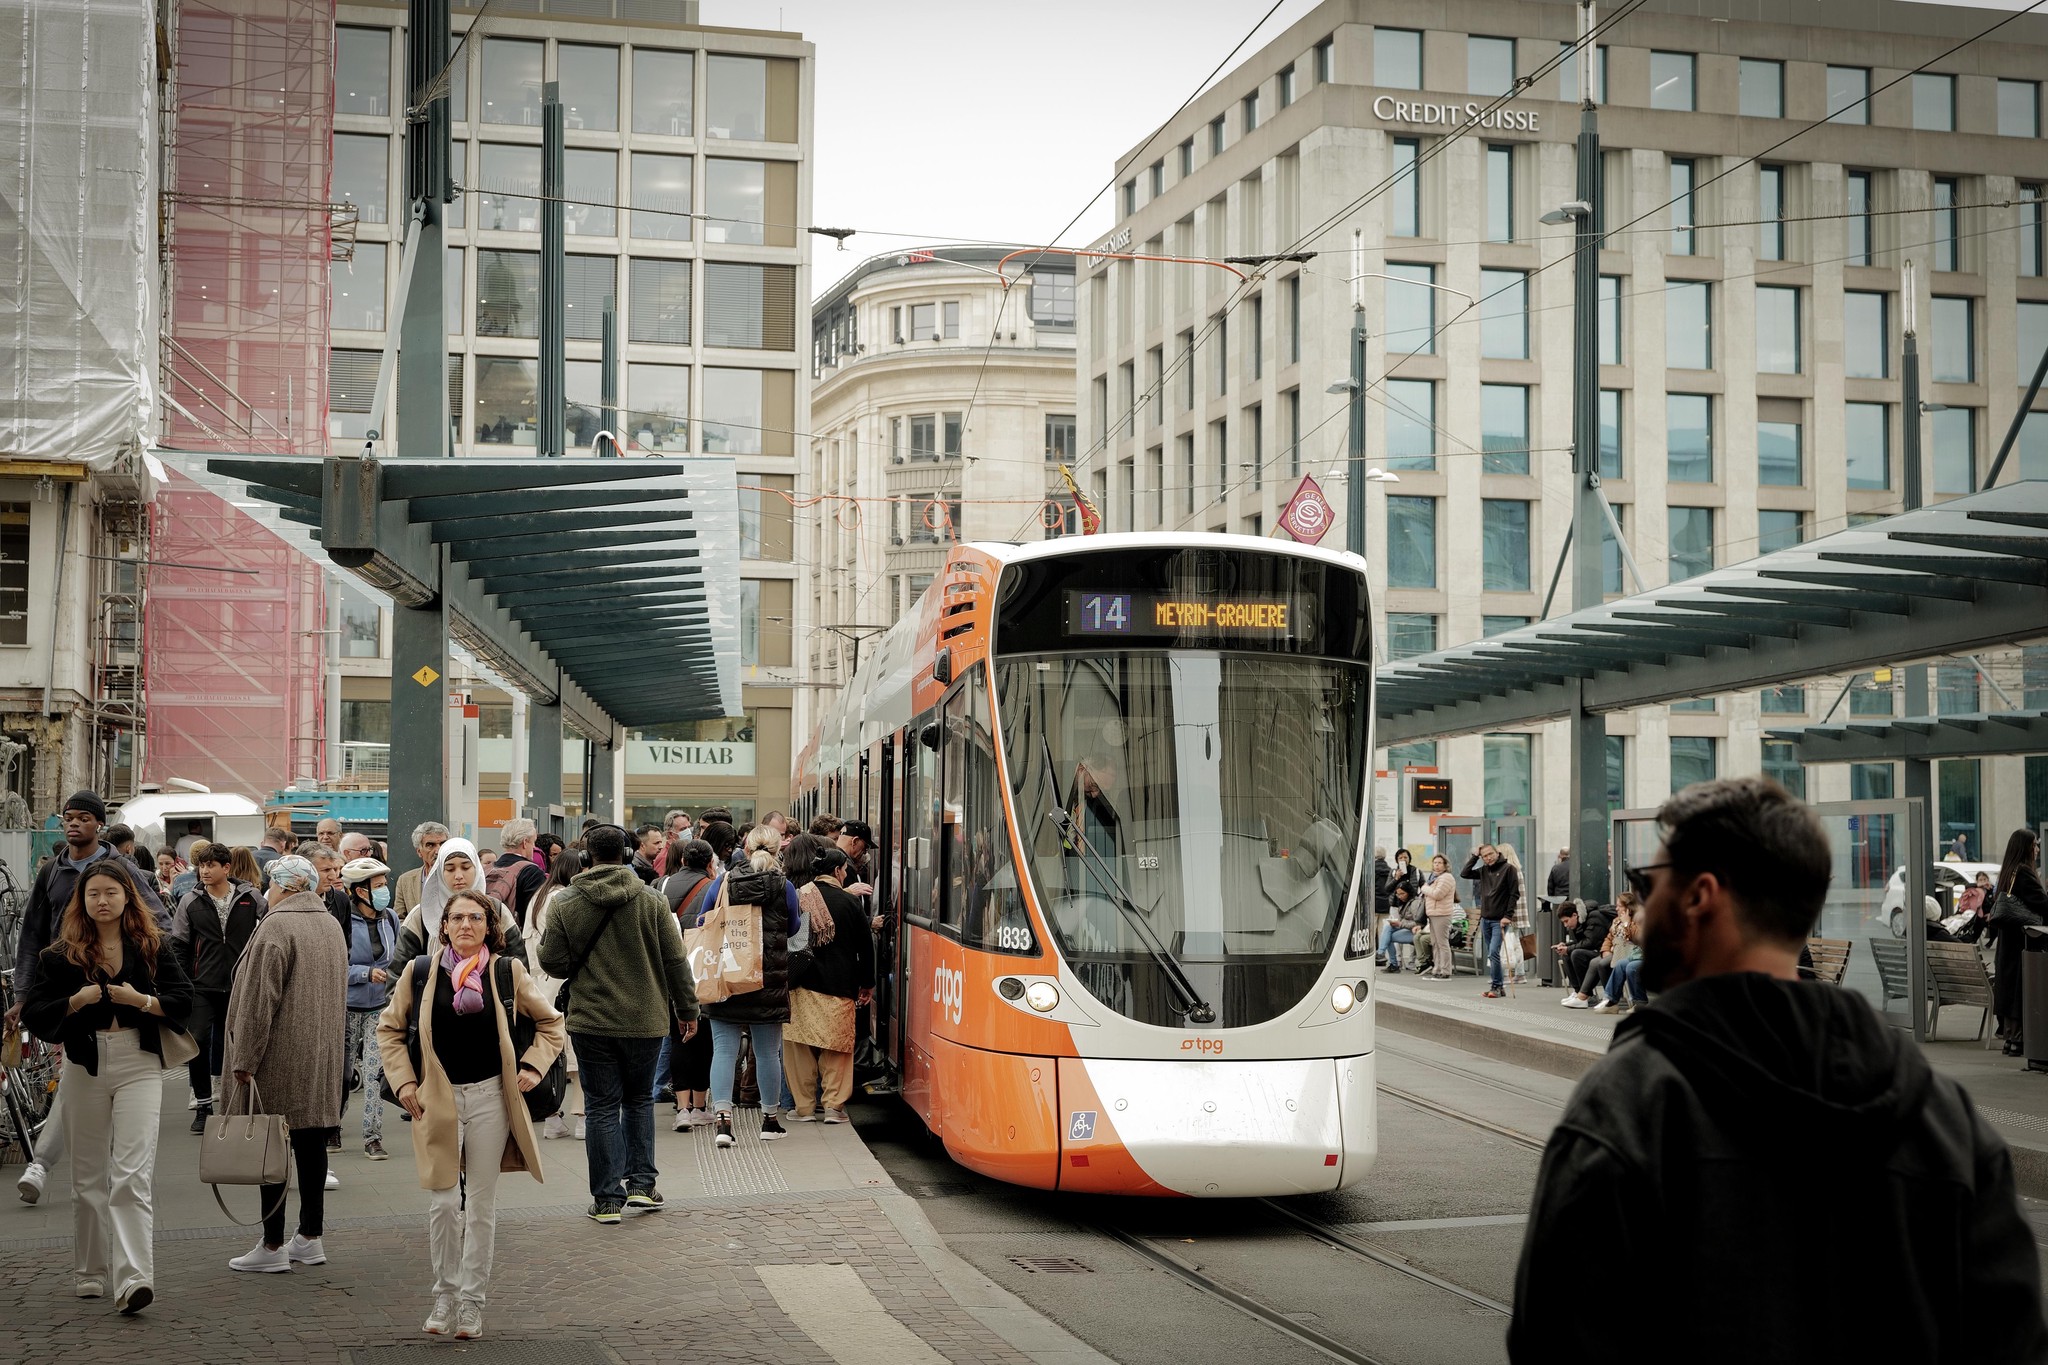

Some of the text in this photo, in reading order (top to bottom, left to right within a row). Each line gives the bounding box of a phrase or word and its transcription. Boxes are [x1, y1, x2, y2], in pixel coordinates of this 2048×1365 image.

[1373, 95, 1540, 132] CREDIT SUISSE
[1110, 227, 1131, 252] SUISSE
[1085, 596, 1287, 629] 14 MEYRIN-GRAVIERE
[648, 746, 733, 765] VISILAB
[731, 929, 748, 938] the
[996, 926, 1030, 950] 1833
